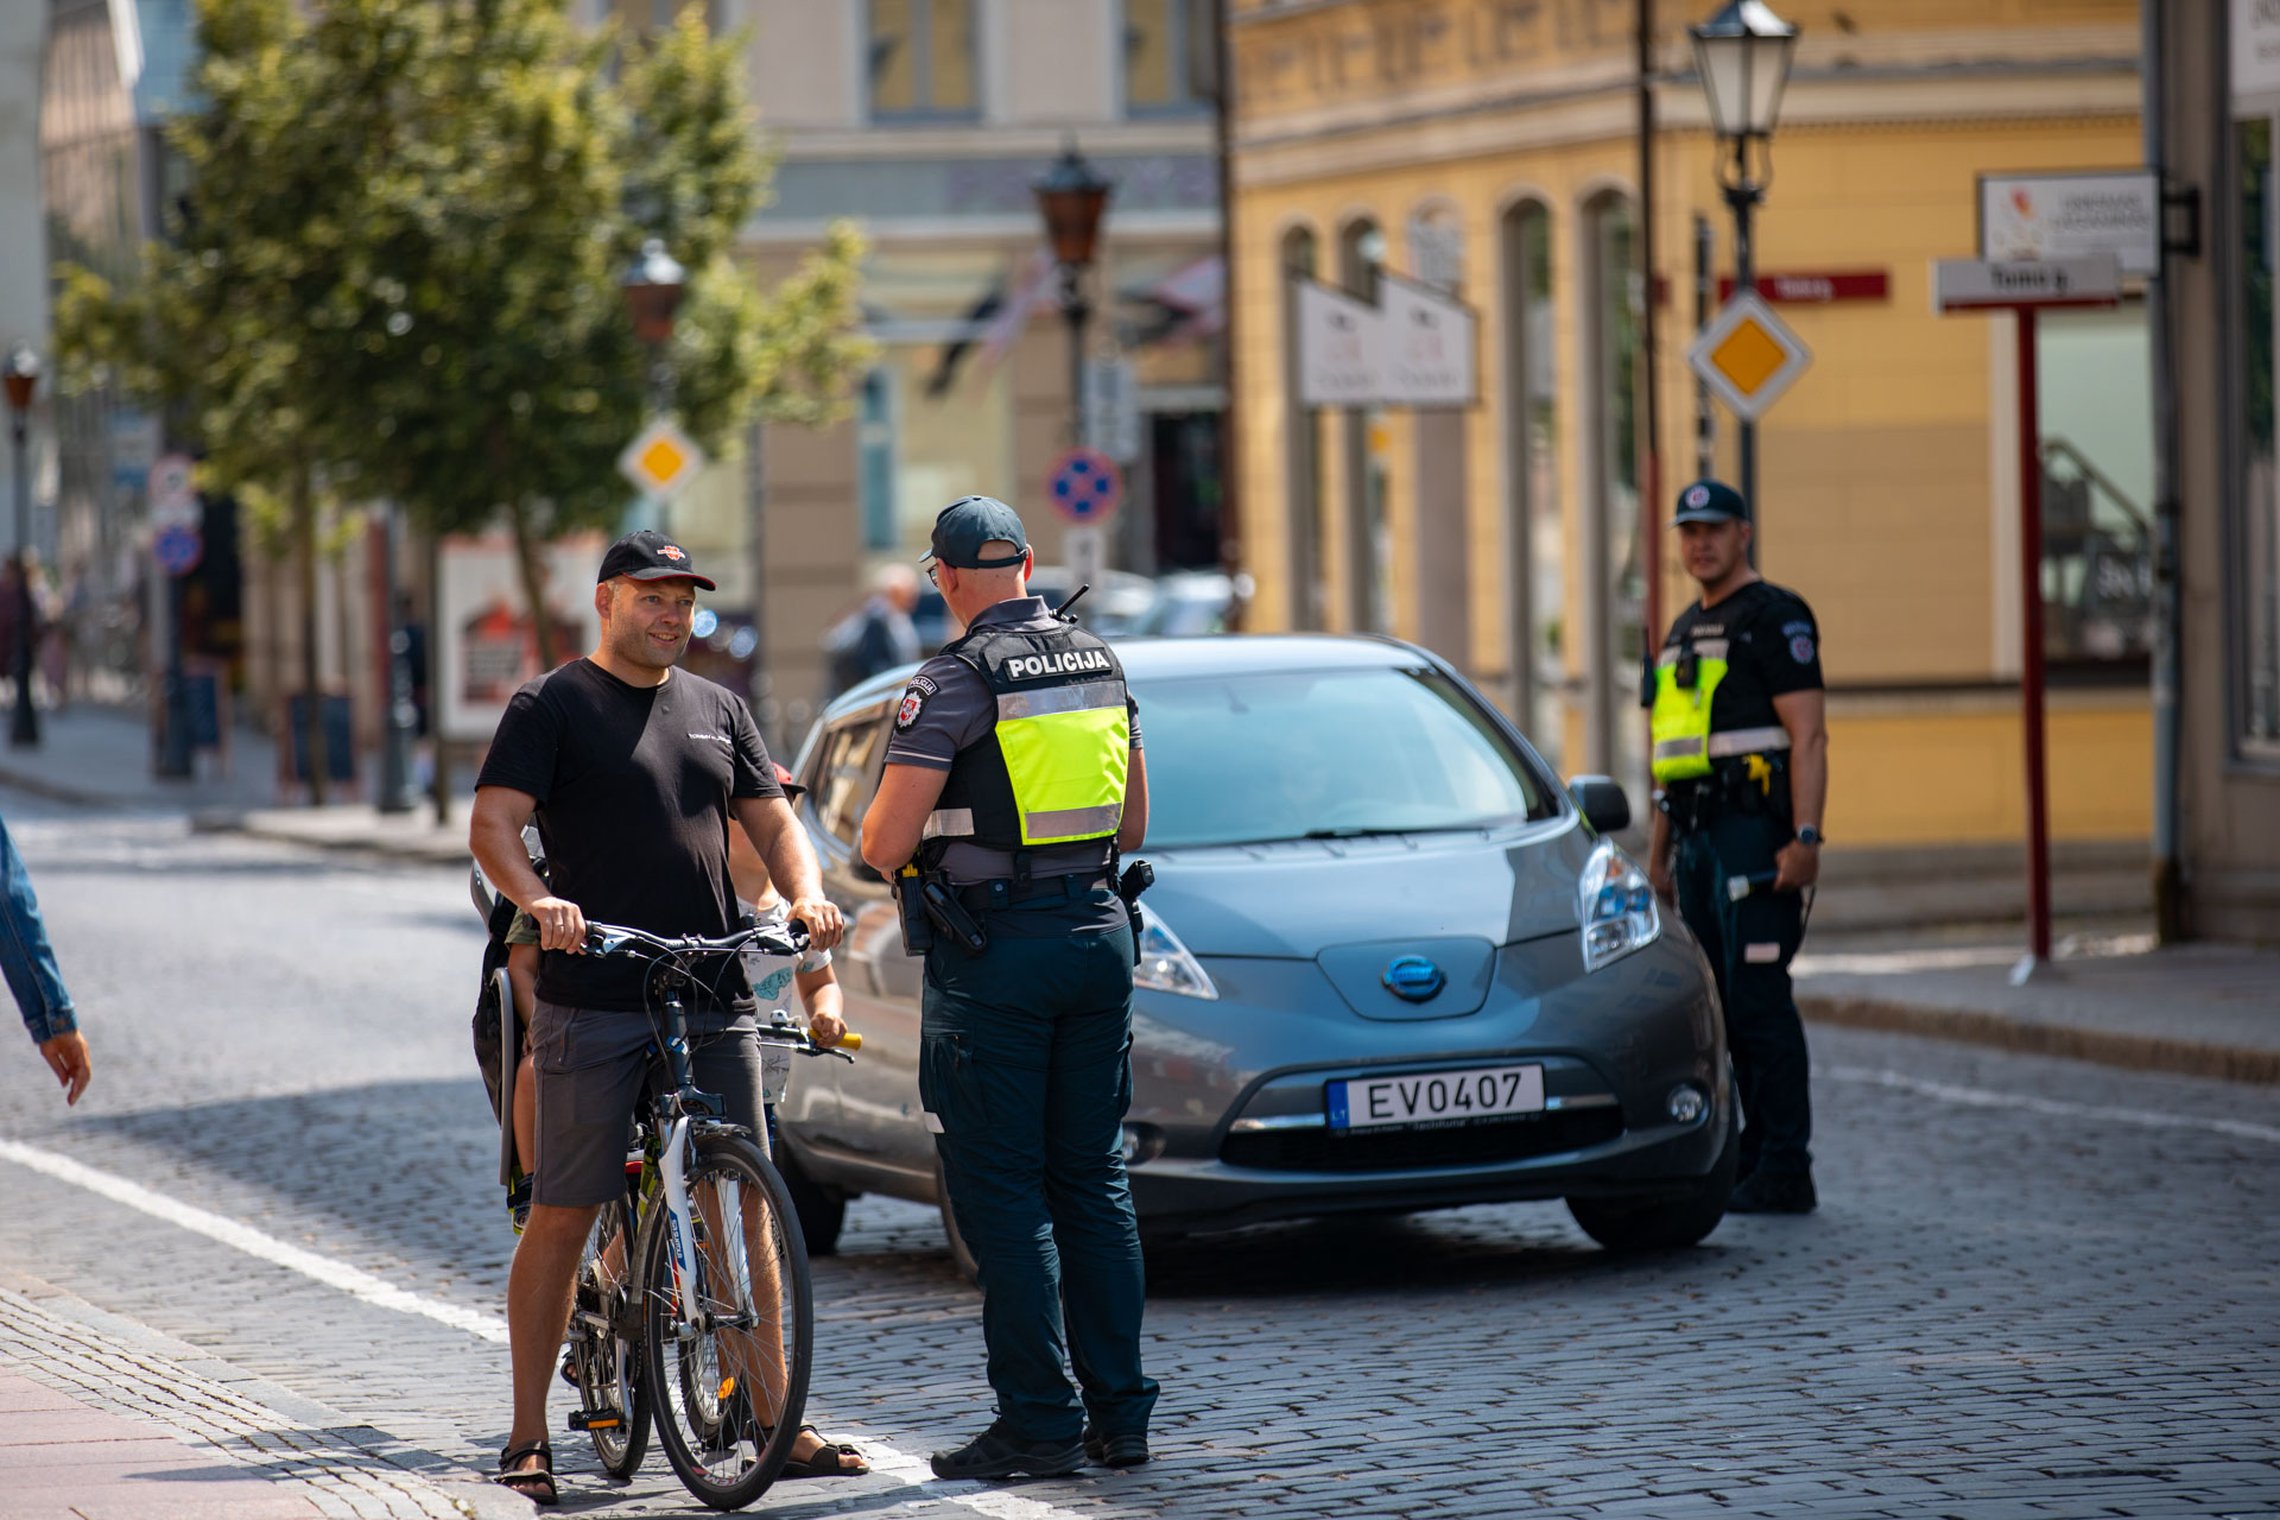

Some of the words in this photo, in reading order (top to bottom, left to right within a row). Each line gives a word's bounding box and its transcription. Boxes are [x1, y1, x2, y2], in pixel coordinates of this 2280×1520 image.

[1008, 650, 1110, 678] POLICIJA
[909, 678, 934, 693] POLICIJA
[1368, 1072, 1521, 1119] EV0407
[1331, 1109, 1346, 1121] LT
